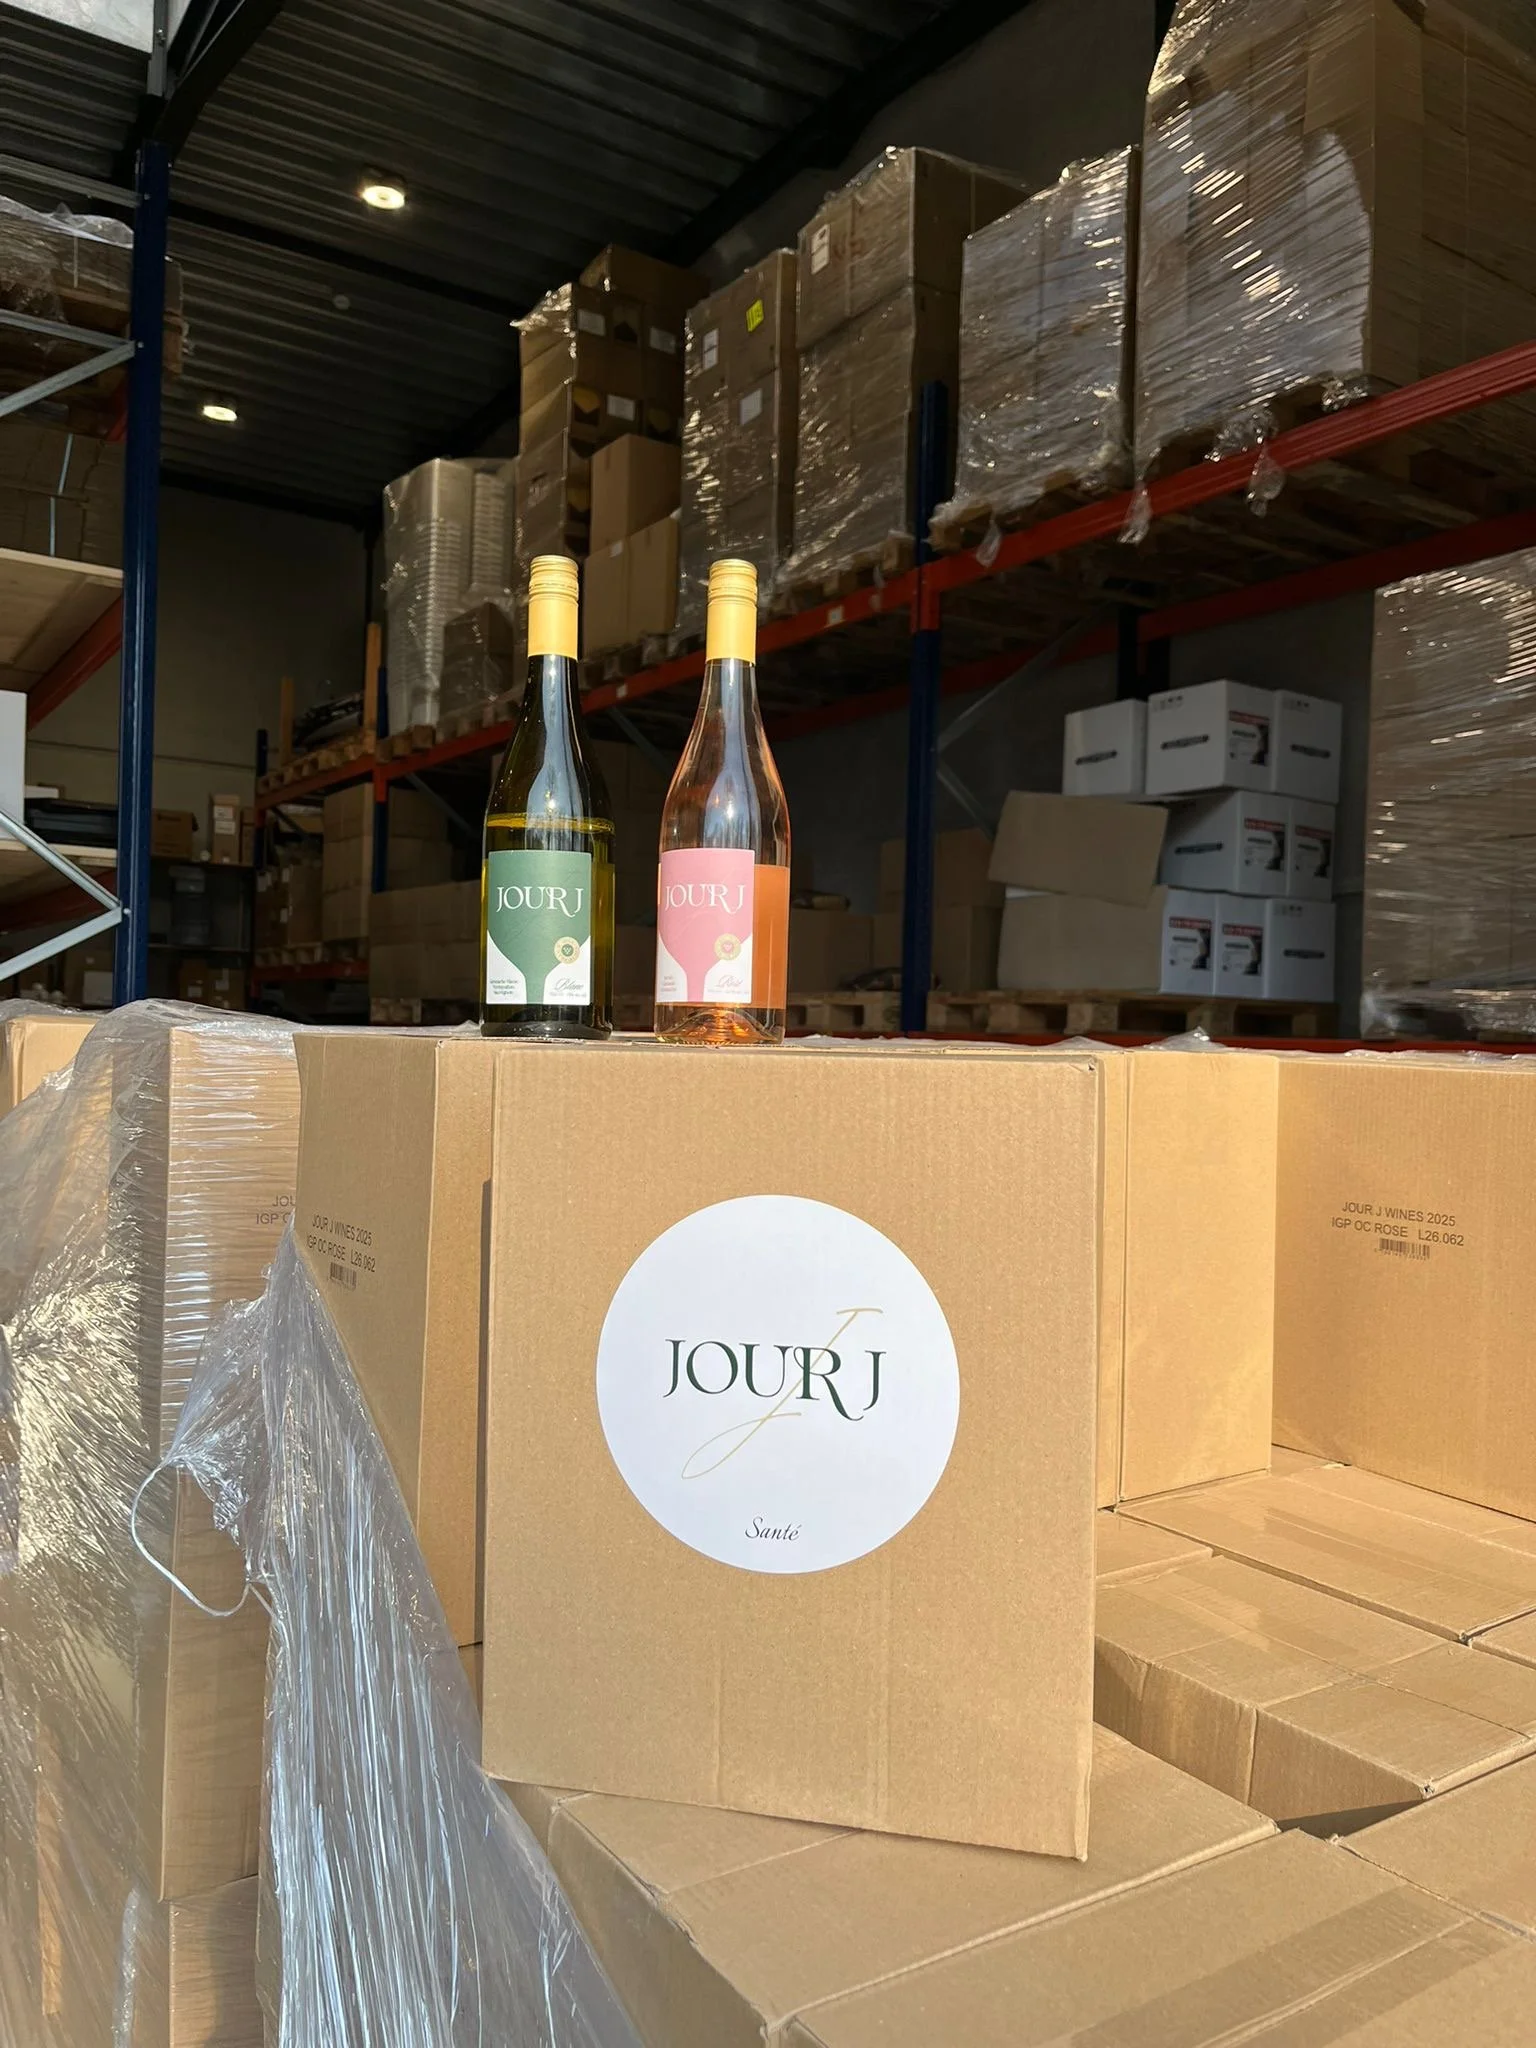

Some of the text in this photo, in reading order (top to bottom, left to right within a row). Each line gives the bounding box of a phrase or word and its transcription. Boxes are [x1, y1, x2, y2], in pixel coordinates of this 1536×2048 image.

[495, 885, 584, 918] JOUR J
[664, 884, 746, 914] JOUR J
[272, 1195, 297, 1207] JOU
[1342, 1201, 1456, 1227] JOUR J WINES 2025
[256, 1212, 279, 1225] IGP
[312, 1214, 328, 1231] JOUR
[334, 1221, 355, 1241] WINES
[355, 1227, 373, 1247] 2025
[1331, 1216, 1465, 1247] IGP OC ROSE L26.062
[327, 1241, 346, 1261] ROSE
[662, 1338, 887, 1422] JOUR J
[744, 1516, 803, 1542] Santé
